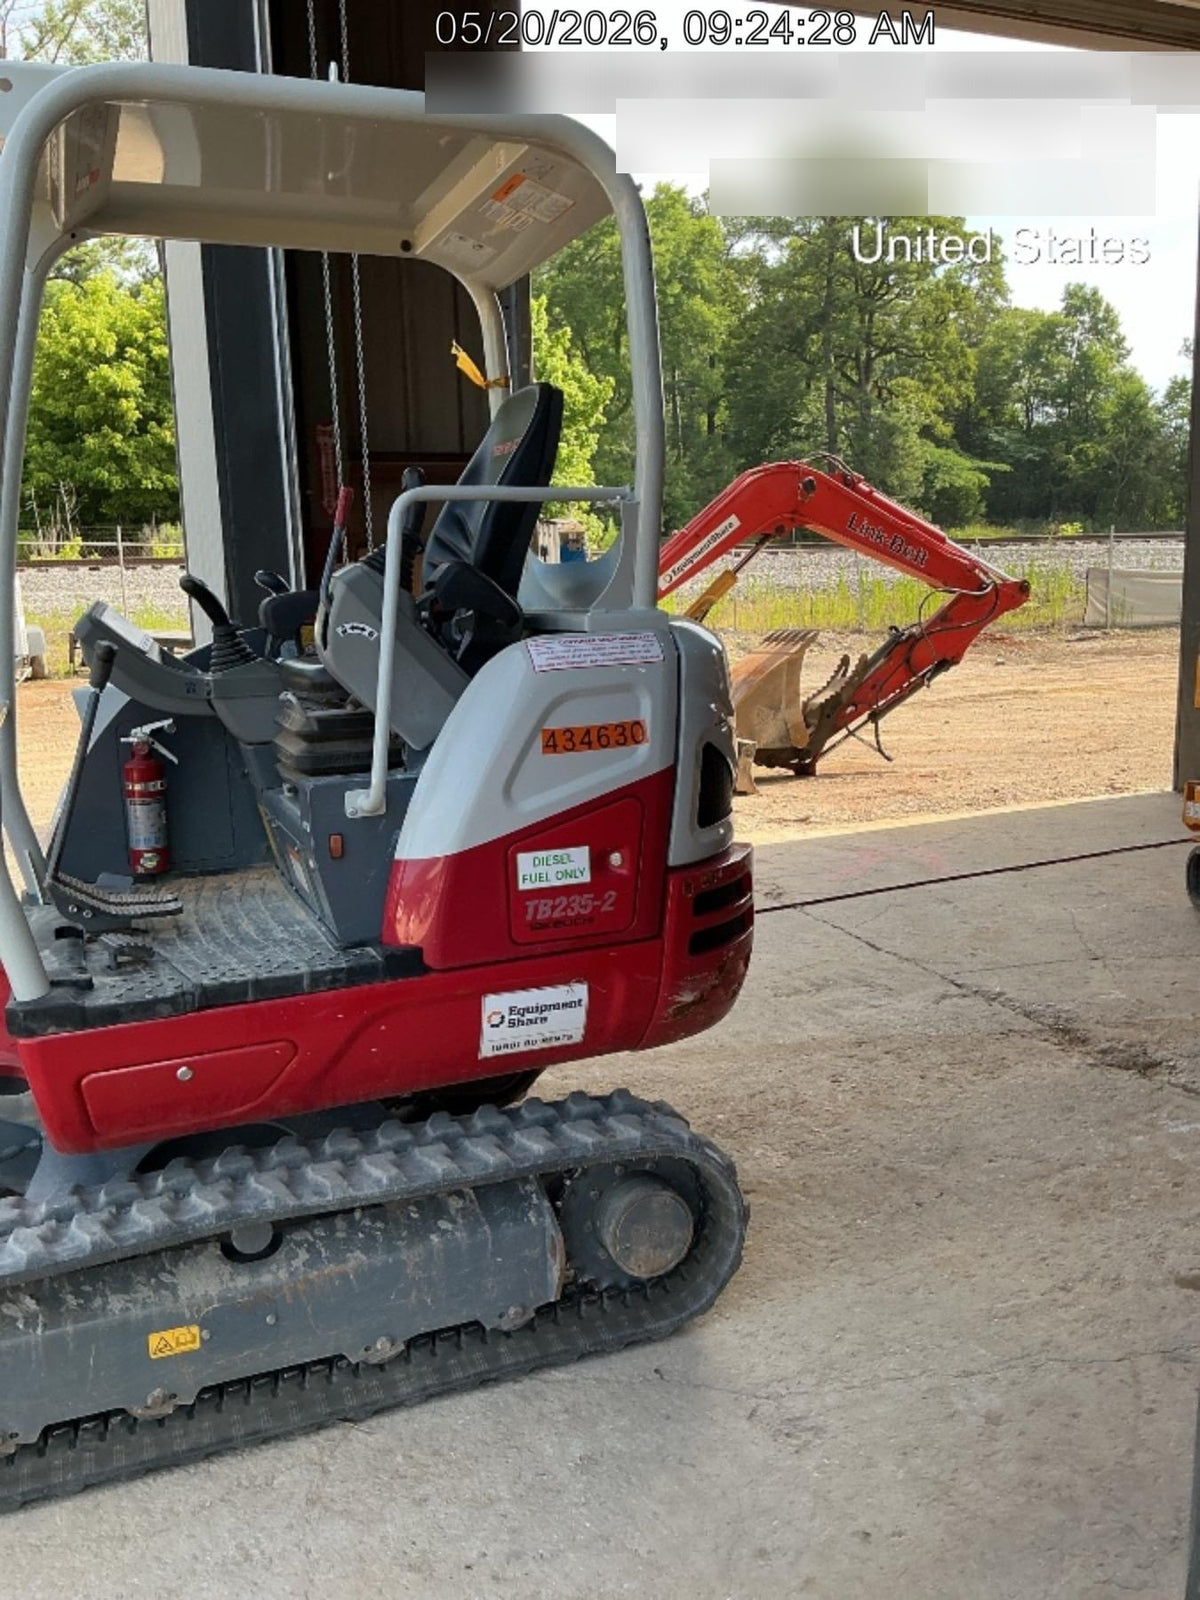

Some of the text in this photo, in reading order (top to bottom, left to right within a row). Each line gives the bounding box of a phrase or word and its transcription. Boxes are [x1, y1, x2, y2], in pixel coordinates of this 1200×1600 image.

[846, 511, 929, 568] Link-Belt
[544, 721, 645, 753] 434630
[532, 853, 575, 868] DIESEL
[522, 867, 586, 884] FUEL ONLY
[525, 890, 618, 921] TB235-2
[507, 998, 583, 1018] Equipment
[507, 1015, 549, 1029] Share
